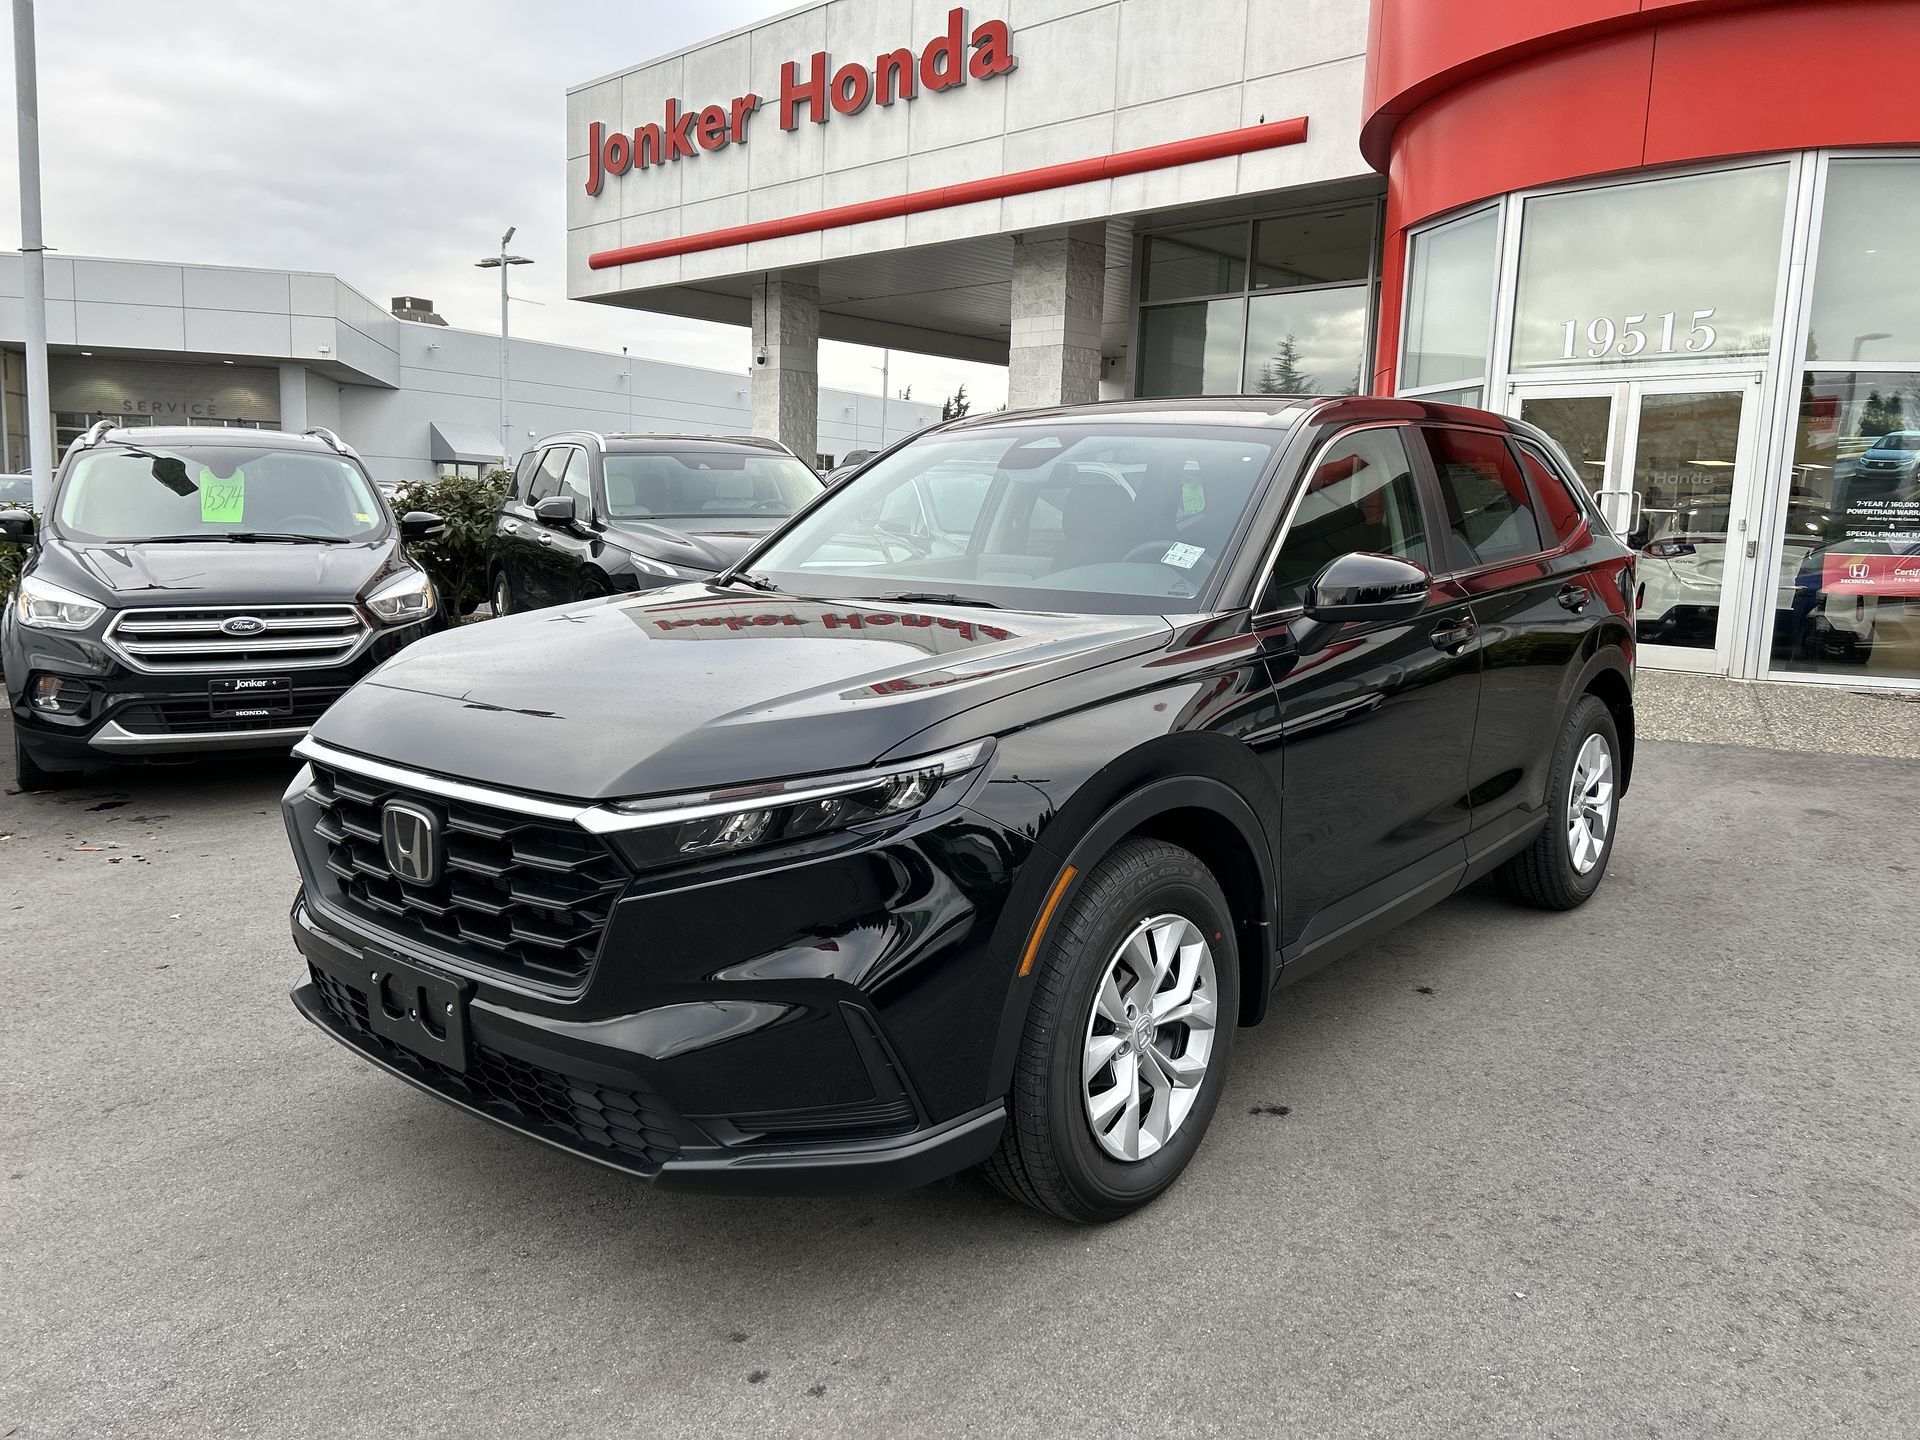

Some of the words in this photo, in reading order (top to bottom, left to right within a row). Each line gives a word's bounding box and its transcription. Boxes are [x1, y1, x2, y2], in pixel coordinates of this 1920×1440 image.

[585, 97, 762, 197] Jonker
[780, 7, 1018, 131] Honda
[1558, 307, 1717, 359] 19515
[123, 400, 217, 415] SERVICE
[1654, 471, 1714, 484] Honda
[231, 620, 256, 630] Ford
[235, 680, 268, 690] Jonker
